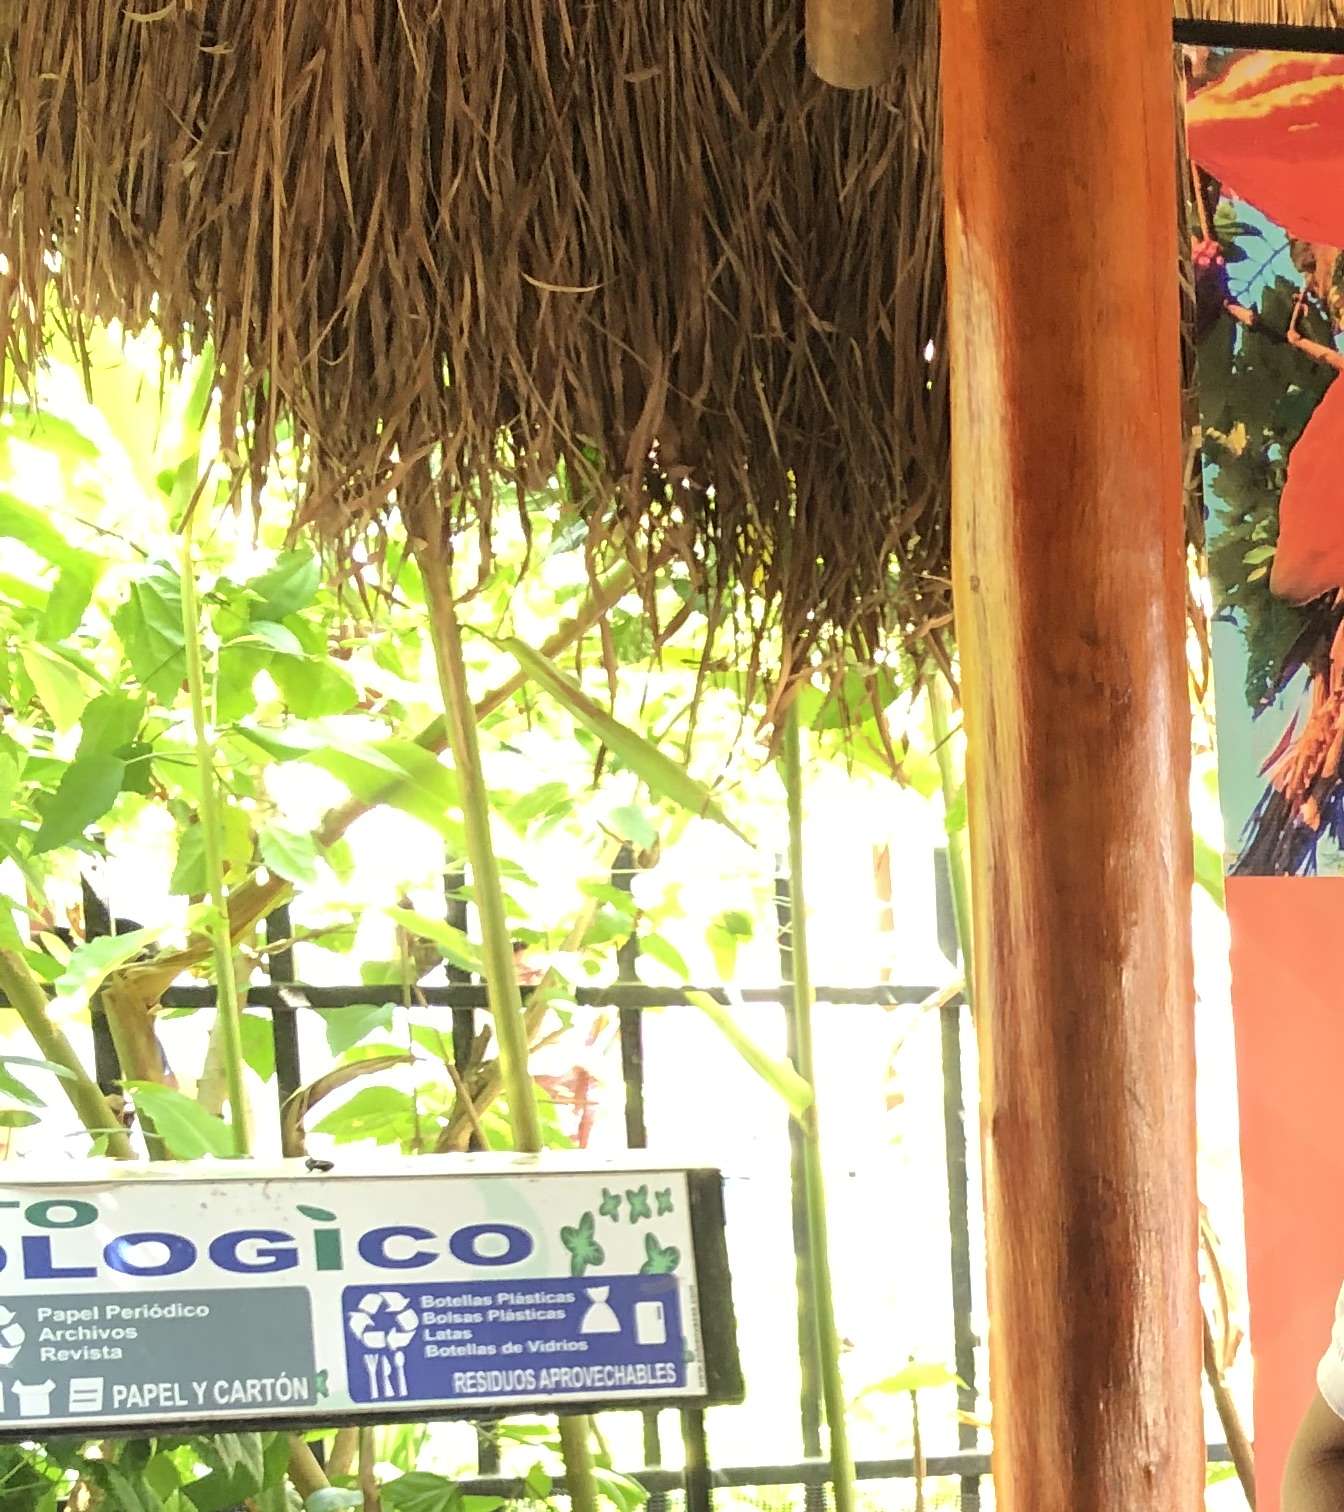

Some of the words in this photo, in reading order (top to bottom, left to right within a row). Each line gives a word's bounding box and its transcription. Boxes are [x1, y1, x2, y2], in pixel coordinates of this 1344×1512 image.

[421, 1294, 493, 1308] Botellas
[498, 1290, 575, 1306] Plásticas
[38, 1306, 99, 1324] Papel
[106, 1303, 210, 1320] Periódico
[422, 1311, 482, 1325] Bolsas
[487, 1307, 566, 1322] Plásticas
[39, 1324, 137, 1342] Archivos
[424, 1328, 472, 1341] Latas
[40, 1346, 123, 1361] Revista
[425, 1343, 496, 1358] Botellas
[502, 1341, 521, 1355] de
[527, 1338, 588, 1353] Vidrios
[454, 1367, 536, 1394] RESIDUOS
[539, 1362, 677, 1389] APROVECHABLES
[113, 1380, 188, 1409] PAPEL
[193, 1380, 207, 1404] Y
[213, 1372, 308, 1404] CARTÓN
